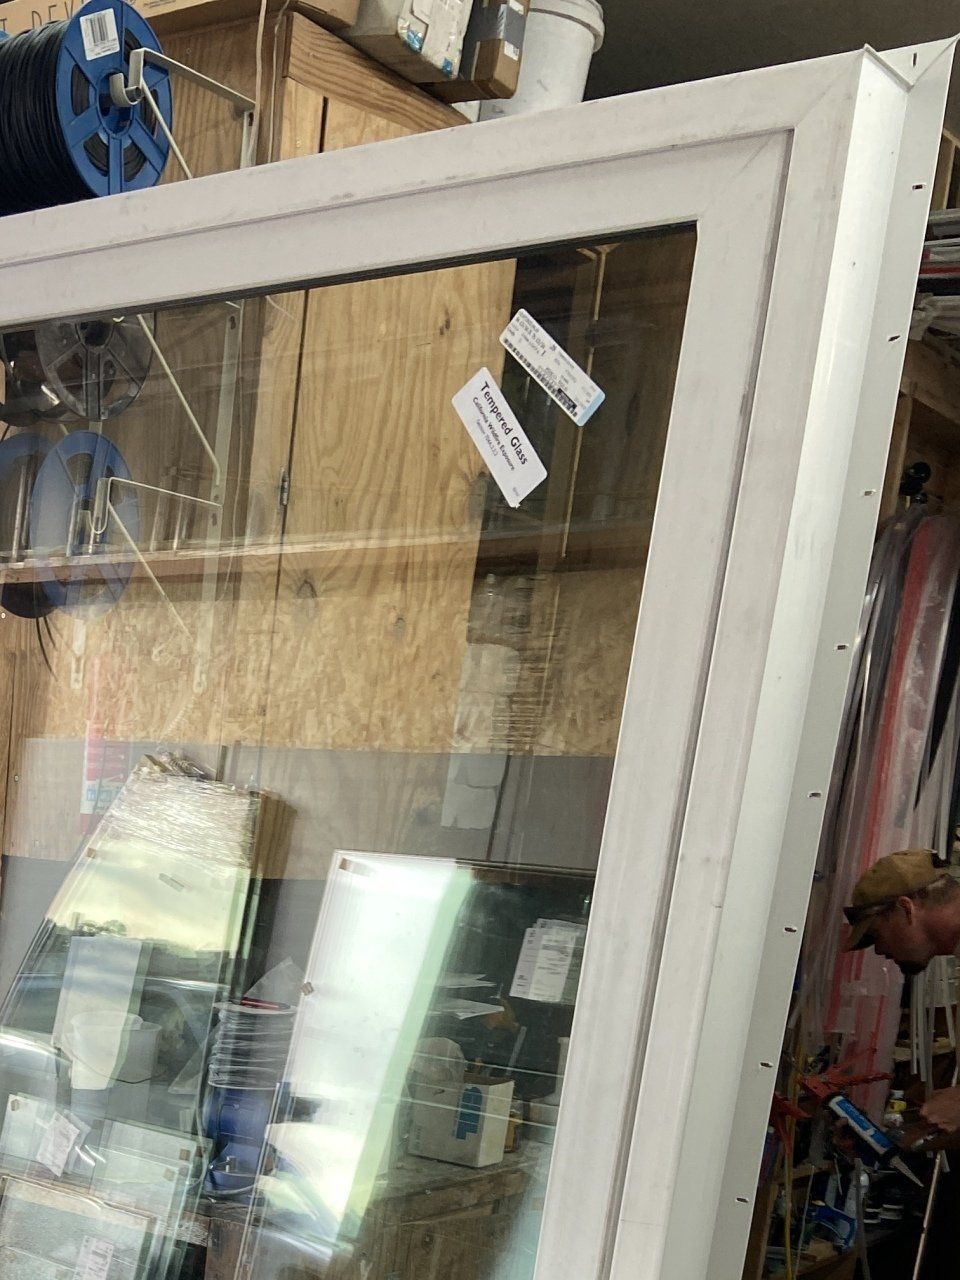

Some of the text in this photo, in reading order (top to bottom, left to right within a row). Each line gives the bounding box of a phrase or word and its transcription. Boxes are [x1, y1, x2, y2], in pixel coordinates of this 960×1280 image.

[473, 396, 515, 471] California Wildfire Exposure
[480, 381, 528, 465] Tempered Glass
